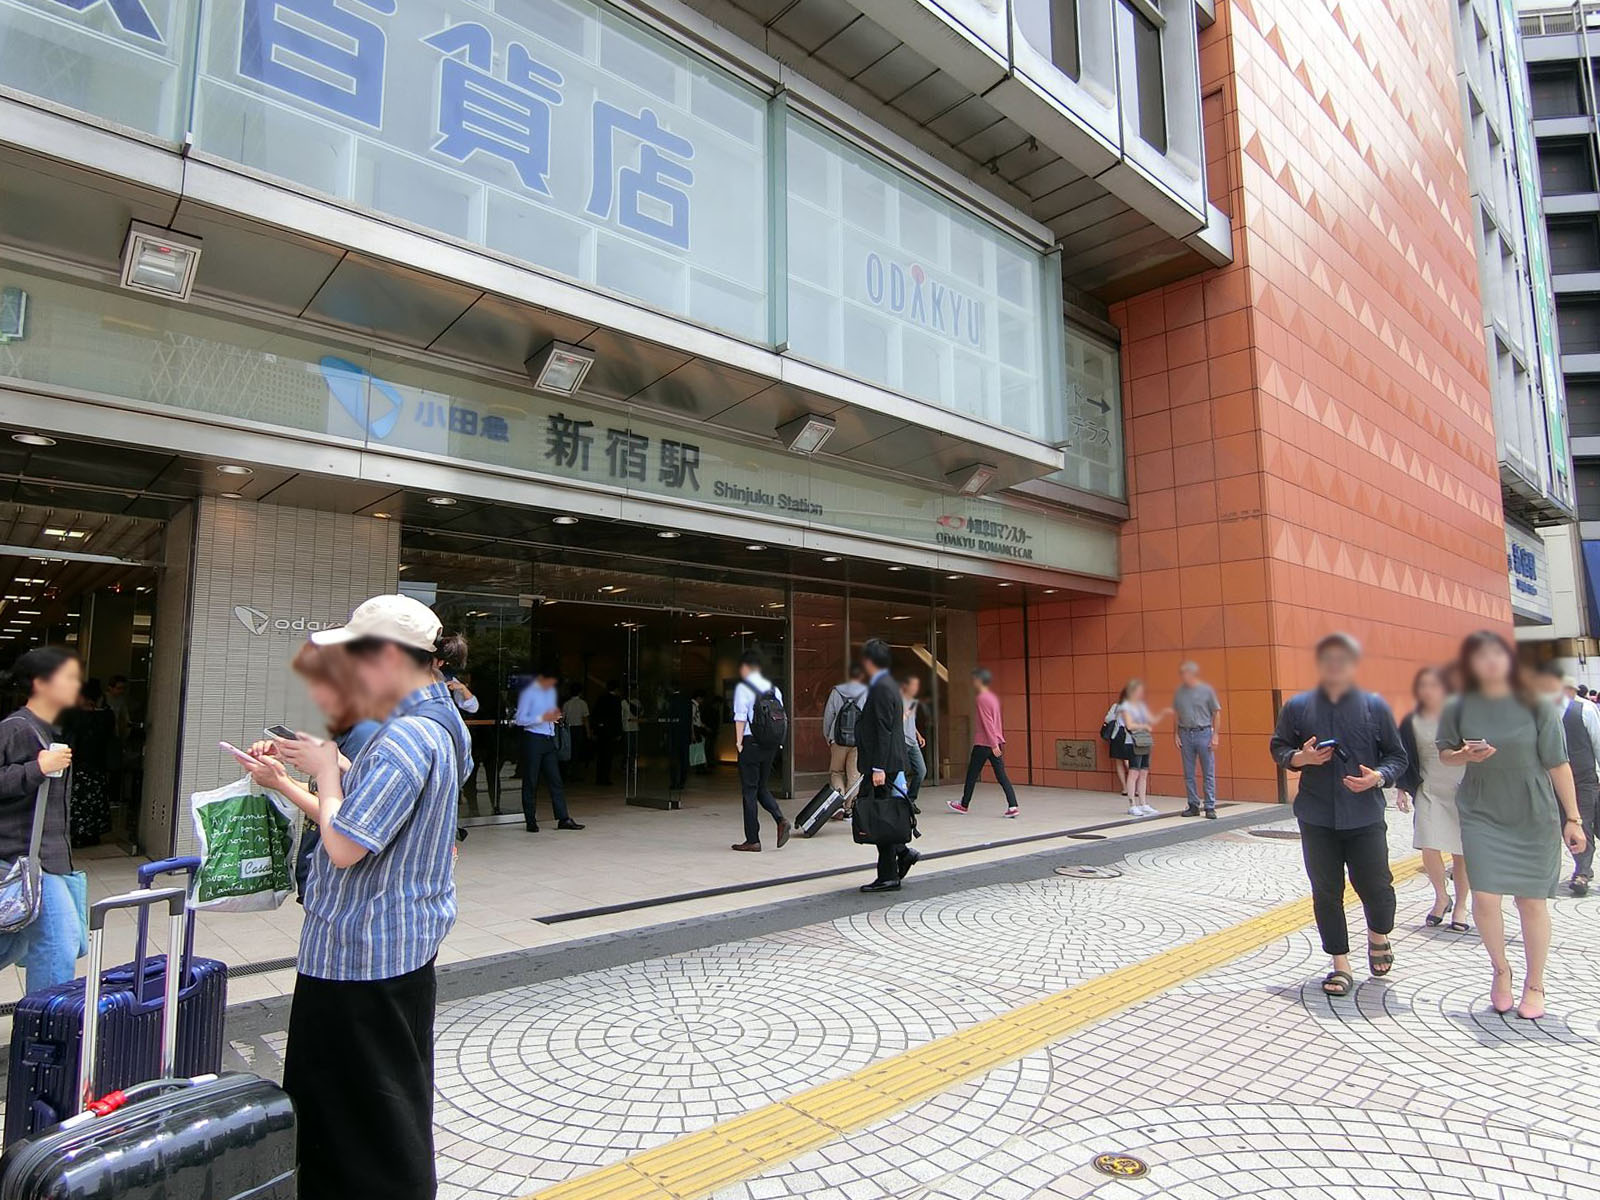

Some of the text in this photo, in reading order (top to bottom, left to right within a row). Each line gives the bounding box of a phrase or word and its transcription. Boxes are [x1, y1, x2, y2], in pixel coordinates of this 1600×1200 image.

[866, 252, 982, 346] ODAKYU
[414, 401, 510, 443] 小田急
[543, 412, 700, 492] 新宿駅
[713, 480, 823, 516] Shinjuku Station
[936, 532, 976, 550] ODAKYU
